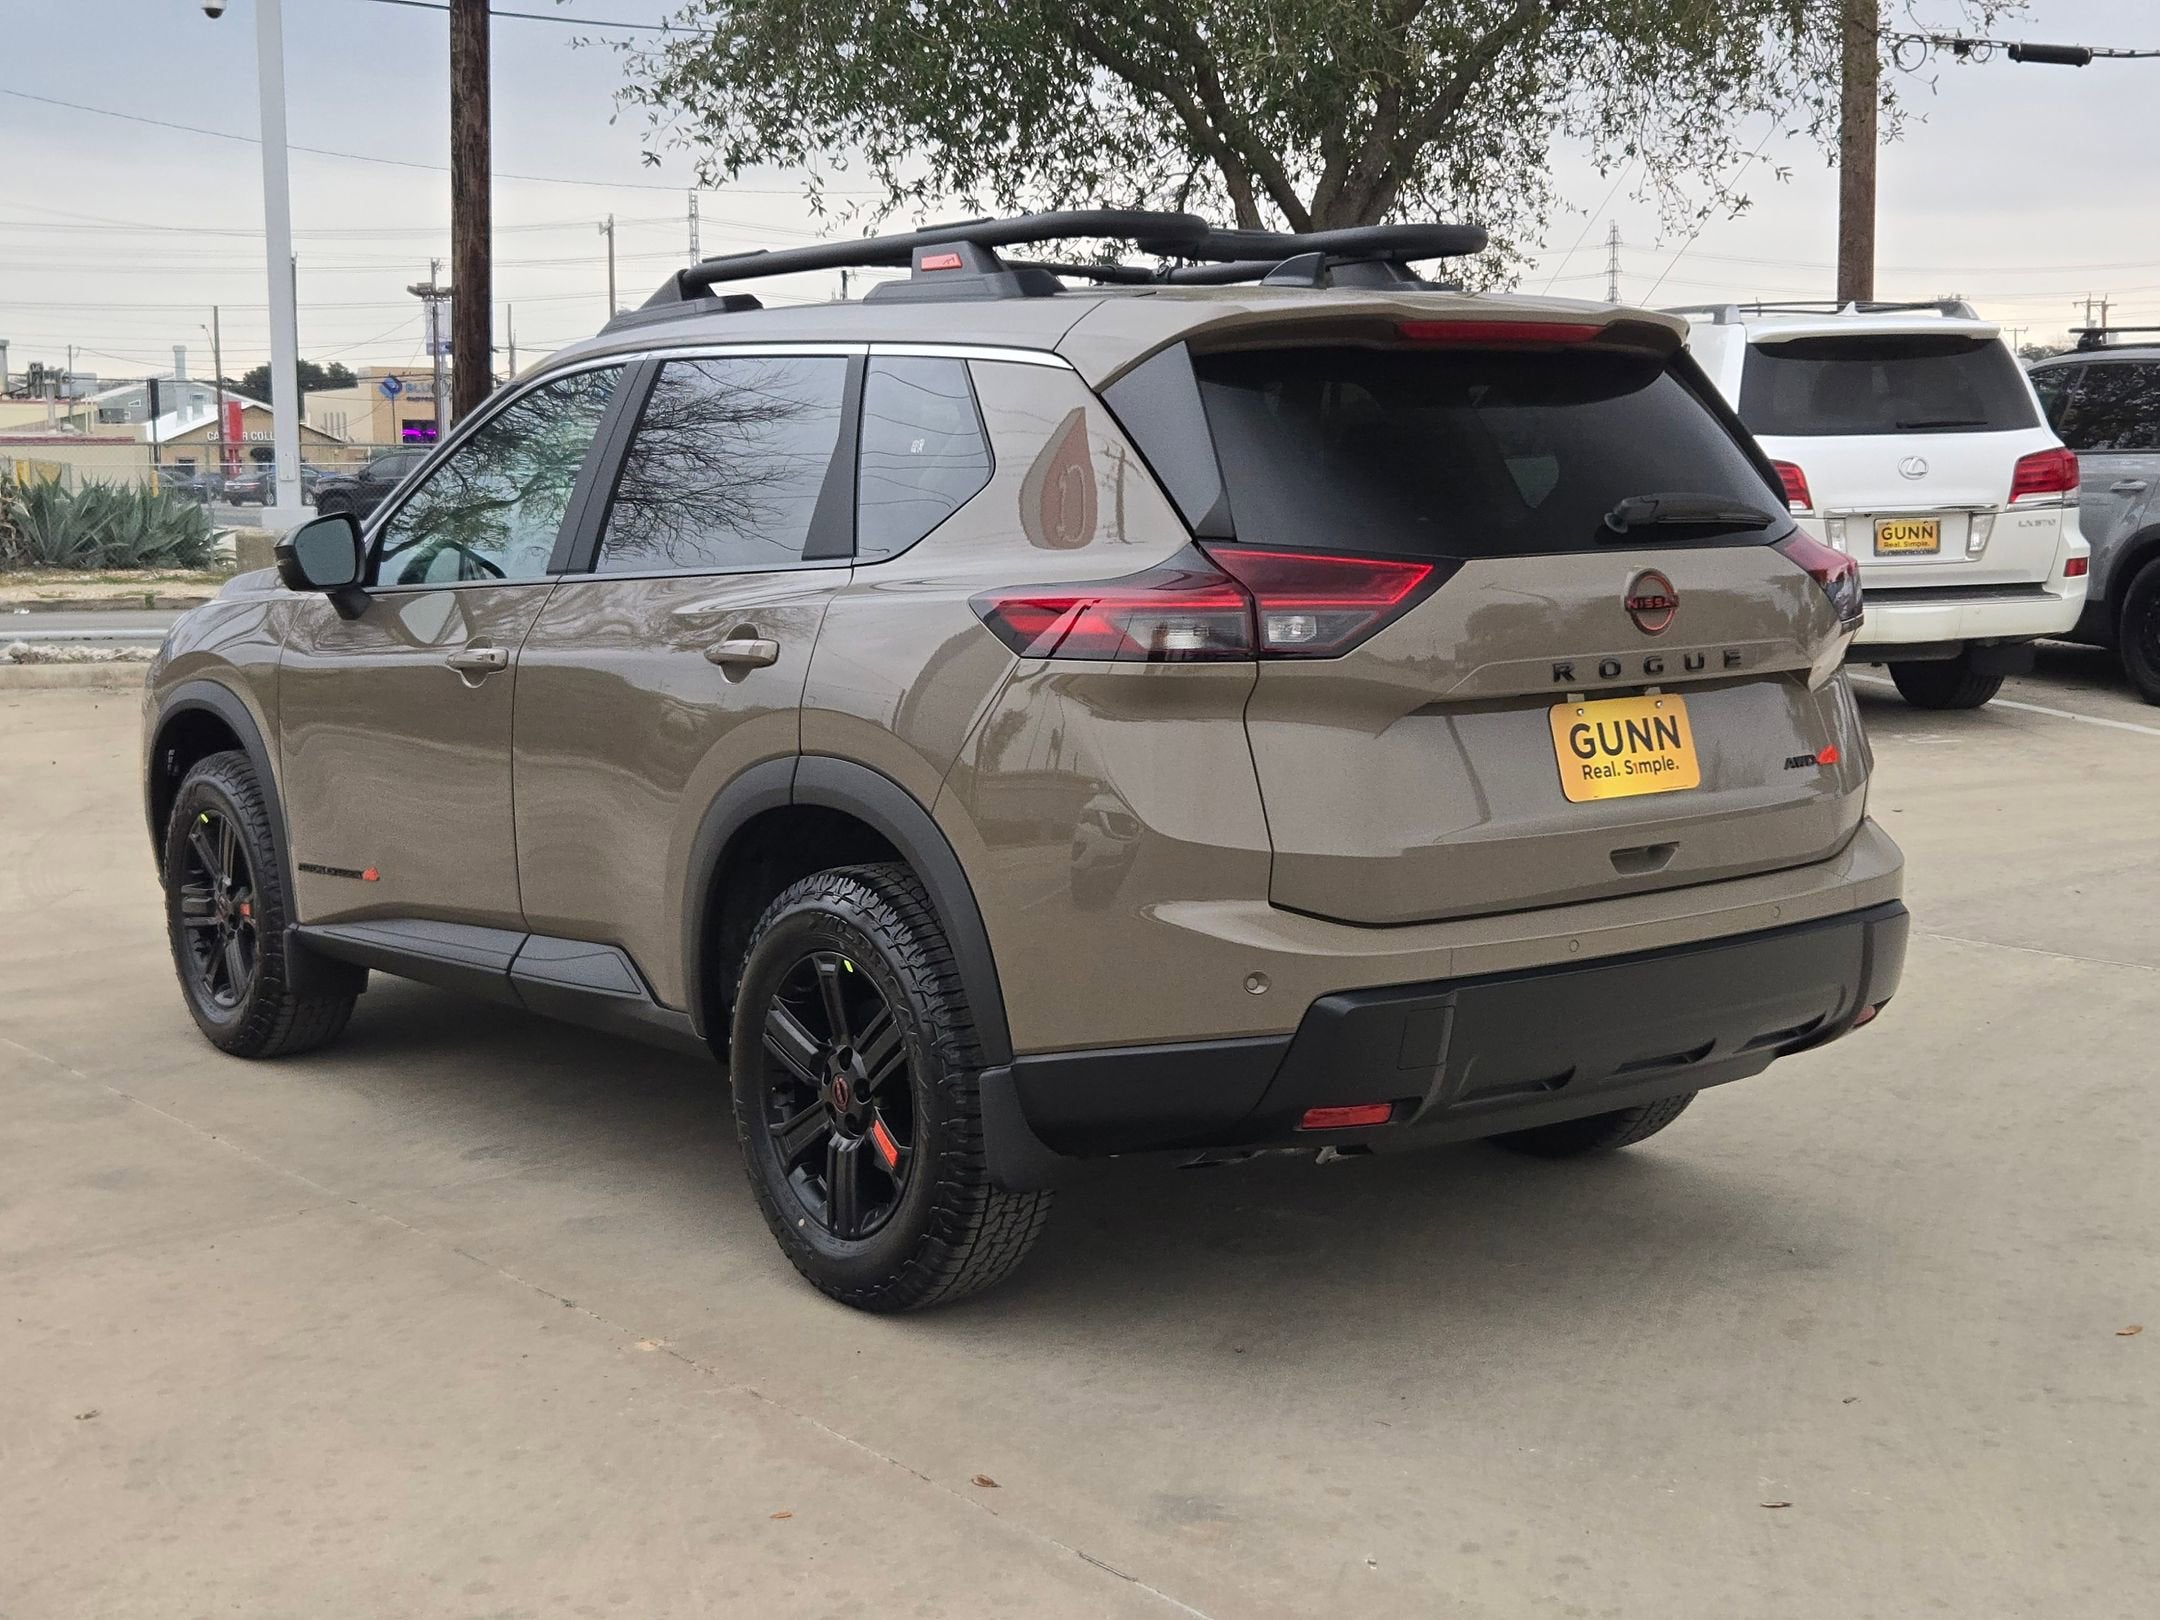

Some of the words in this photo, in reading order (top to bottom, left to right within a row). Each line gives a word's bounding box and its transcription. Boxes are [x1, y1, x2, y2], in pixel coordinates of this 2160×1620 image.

[1881, 525, 1934, 540] GUNN
[1627, 595, 1678, 609] NISSAN
[1552, 651, 1742, 682] ROGUE
[1569, 714, 1682, 760] GUNN
[1581, 761, 1621, 780] Real.
[1784, 754, 1817, 770] AWD
